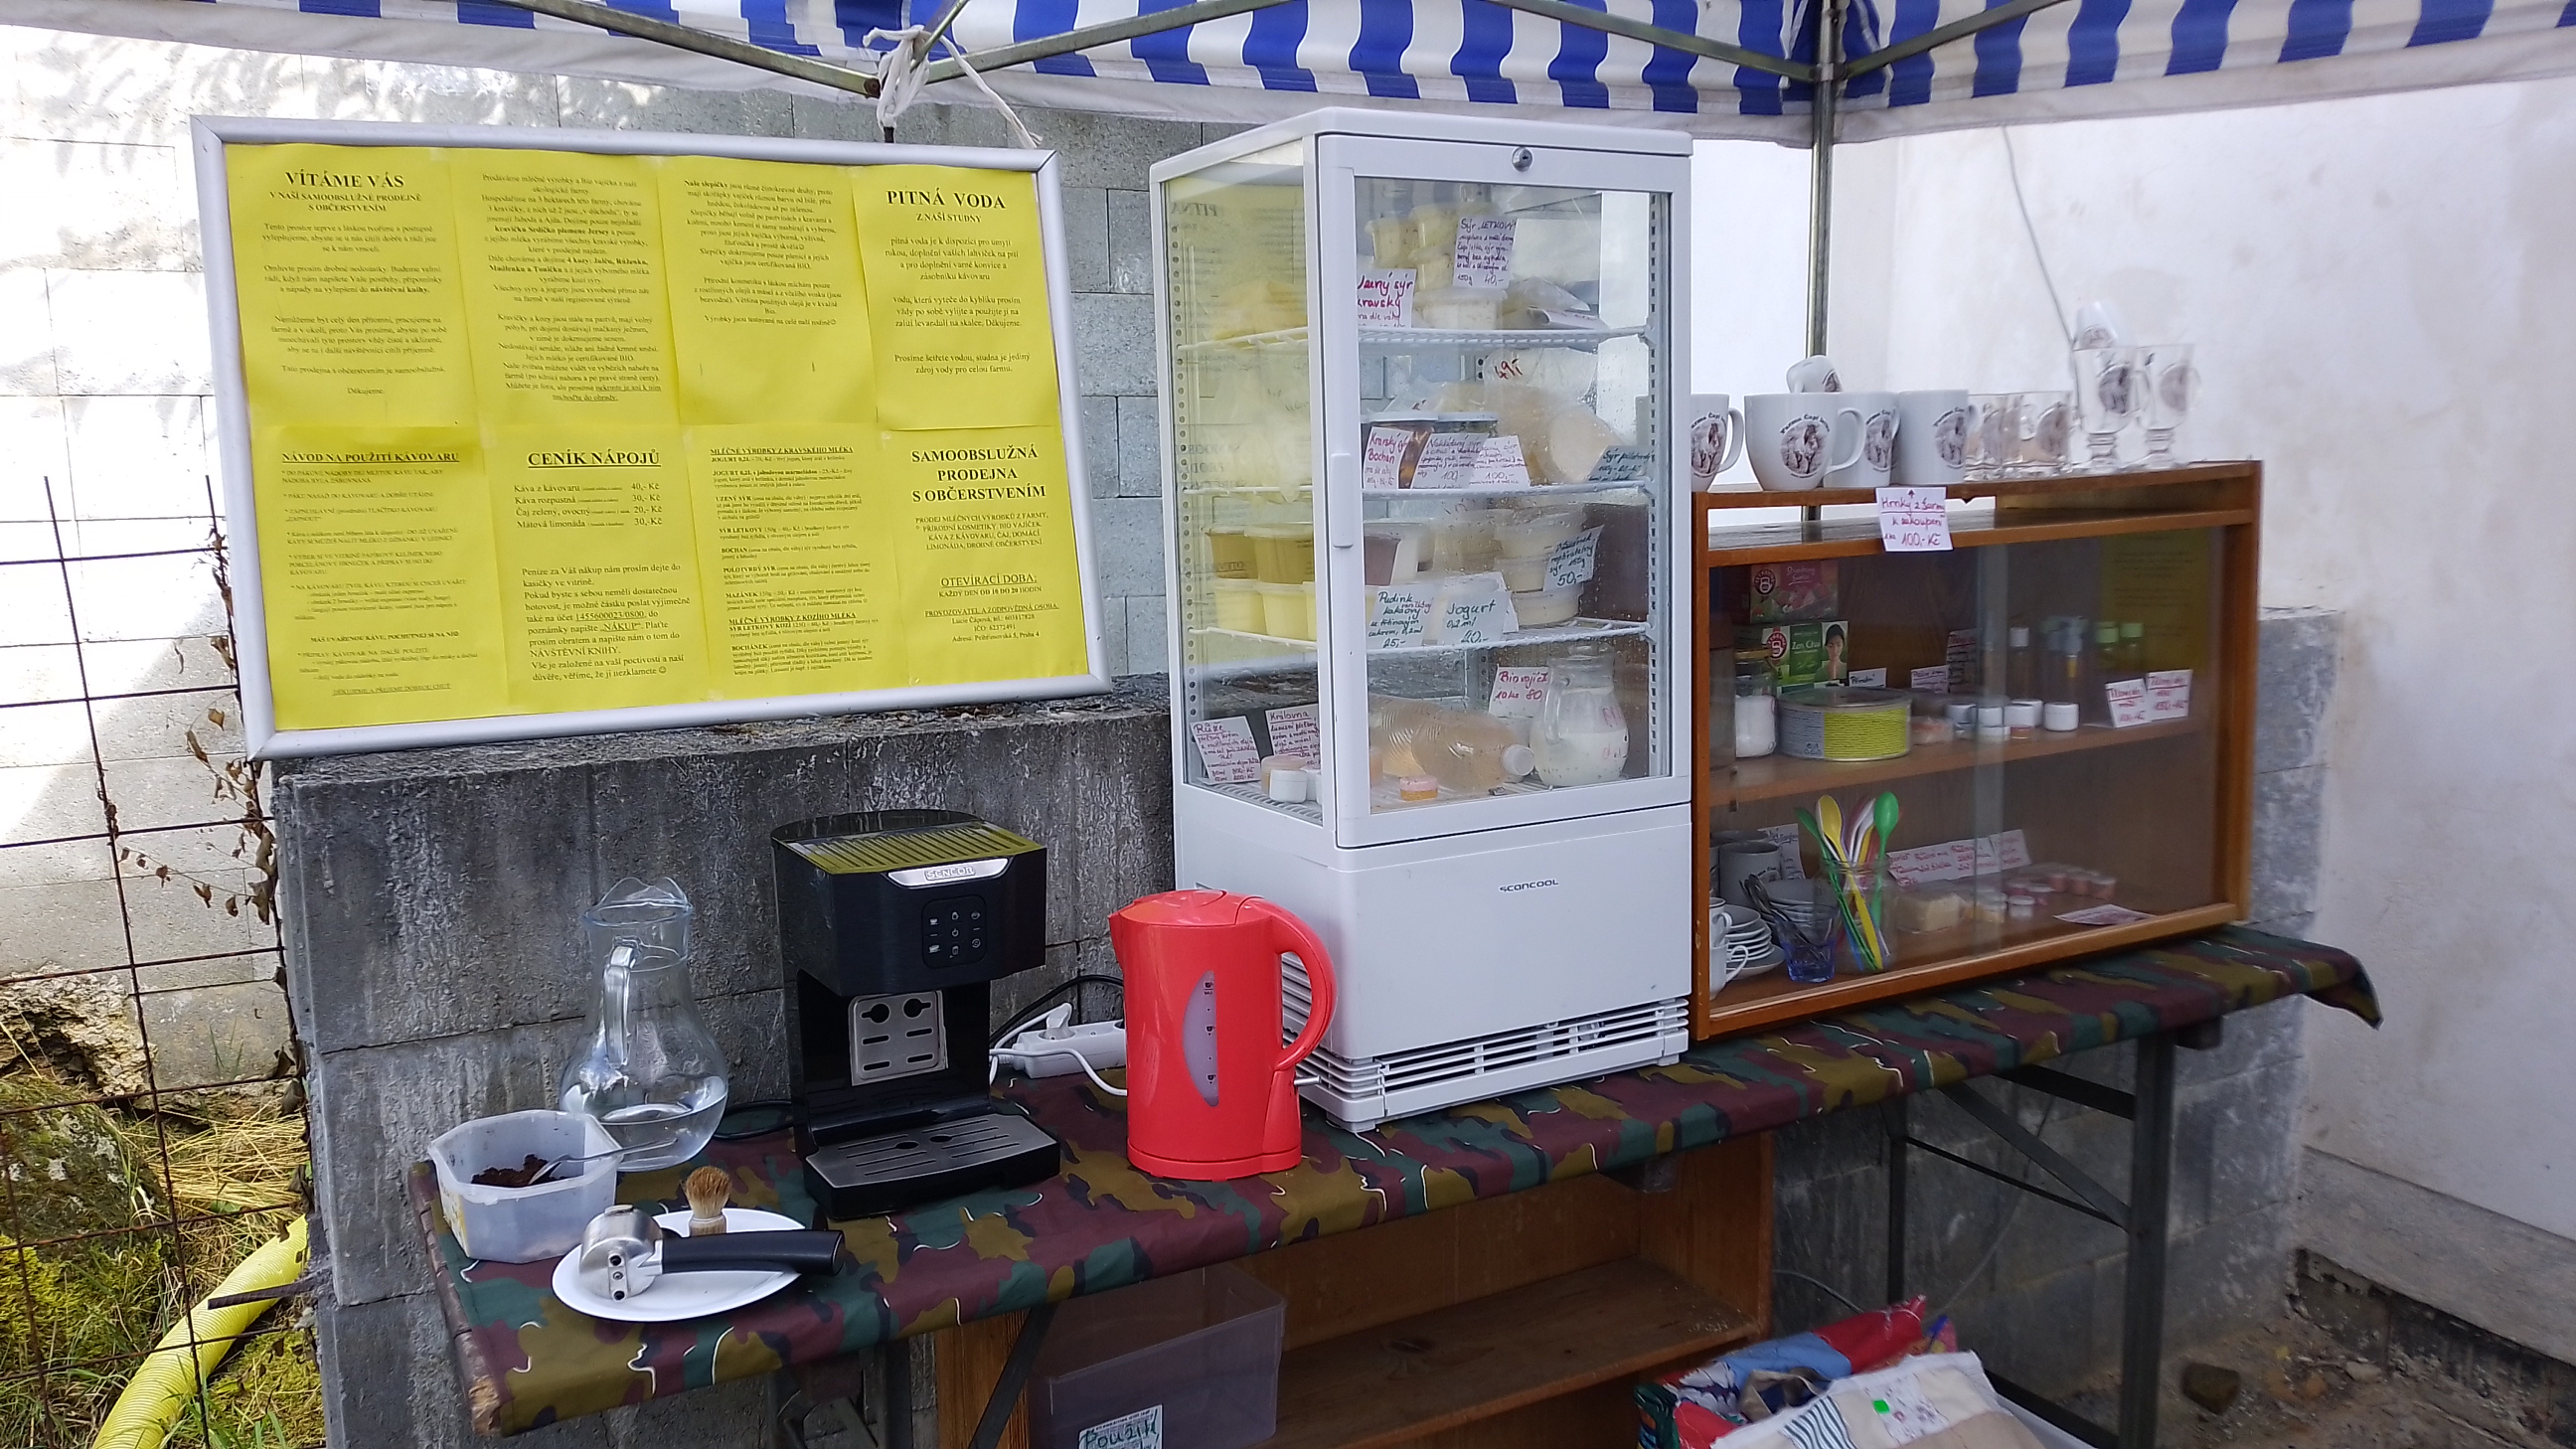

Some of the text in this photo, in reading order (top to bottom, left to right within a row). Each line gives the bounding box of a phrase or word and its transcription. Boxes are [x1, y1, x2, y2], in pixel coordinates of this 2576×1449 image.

[285, 169, 403, 188] VÍTÁME VÁS
[278, 191, 299, 200] NAŠÍ
[887, 189, 1005, 209] PITNÁ VODA
[924, 213, 945, 222] NAŠÍ
[947, 214, 981, 224] STUDNY
[1461, 219, 1476, 233] Sýr
[1394, 273, 1413, 296] sýr
[282, 452, 324, 462] NÁVOD
[346, 452, 392, 462] POUŽITÍ
[395, 453, 459, 462] KÁVOVARU
[529, 449, 659, 465] CENÍK NÁPOJŮ
[911, 444, 1038, 462] SAMOOBSLUŽNÁ
[938, 468, 1017, 481] PRODEJNA
[514, 485, 535, 494] Káva
[912, 483, 1046, 502] S OBČERSTVENÍM
[515, 497, 536, 506] Káva
[516, 508, 530, 517] Čaj
[532, 508, 561, 517] zelený,
[563, 508, 591, 517] ovocný
[578, 566, 602, 575] nákup
[622, 564, 649, 573] prosím
[650, 564, 669, 572] dejte
[941, 573, 1038, 587] OTEVÍRACÍ DOBA:
[1557, 571, 1583, 586] 50,-
[1378, 591, 1413, 603] Pudink
[1446, 599, 1497, 619] Jogurt
[530, 646, 621, 658] NÁVŠTĚVNÍ KNIHY.
[925, 866, 975, 880] SENCOR
